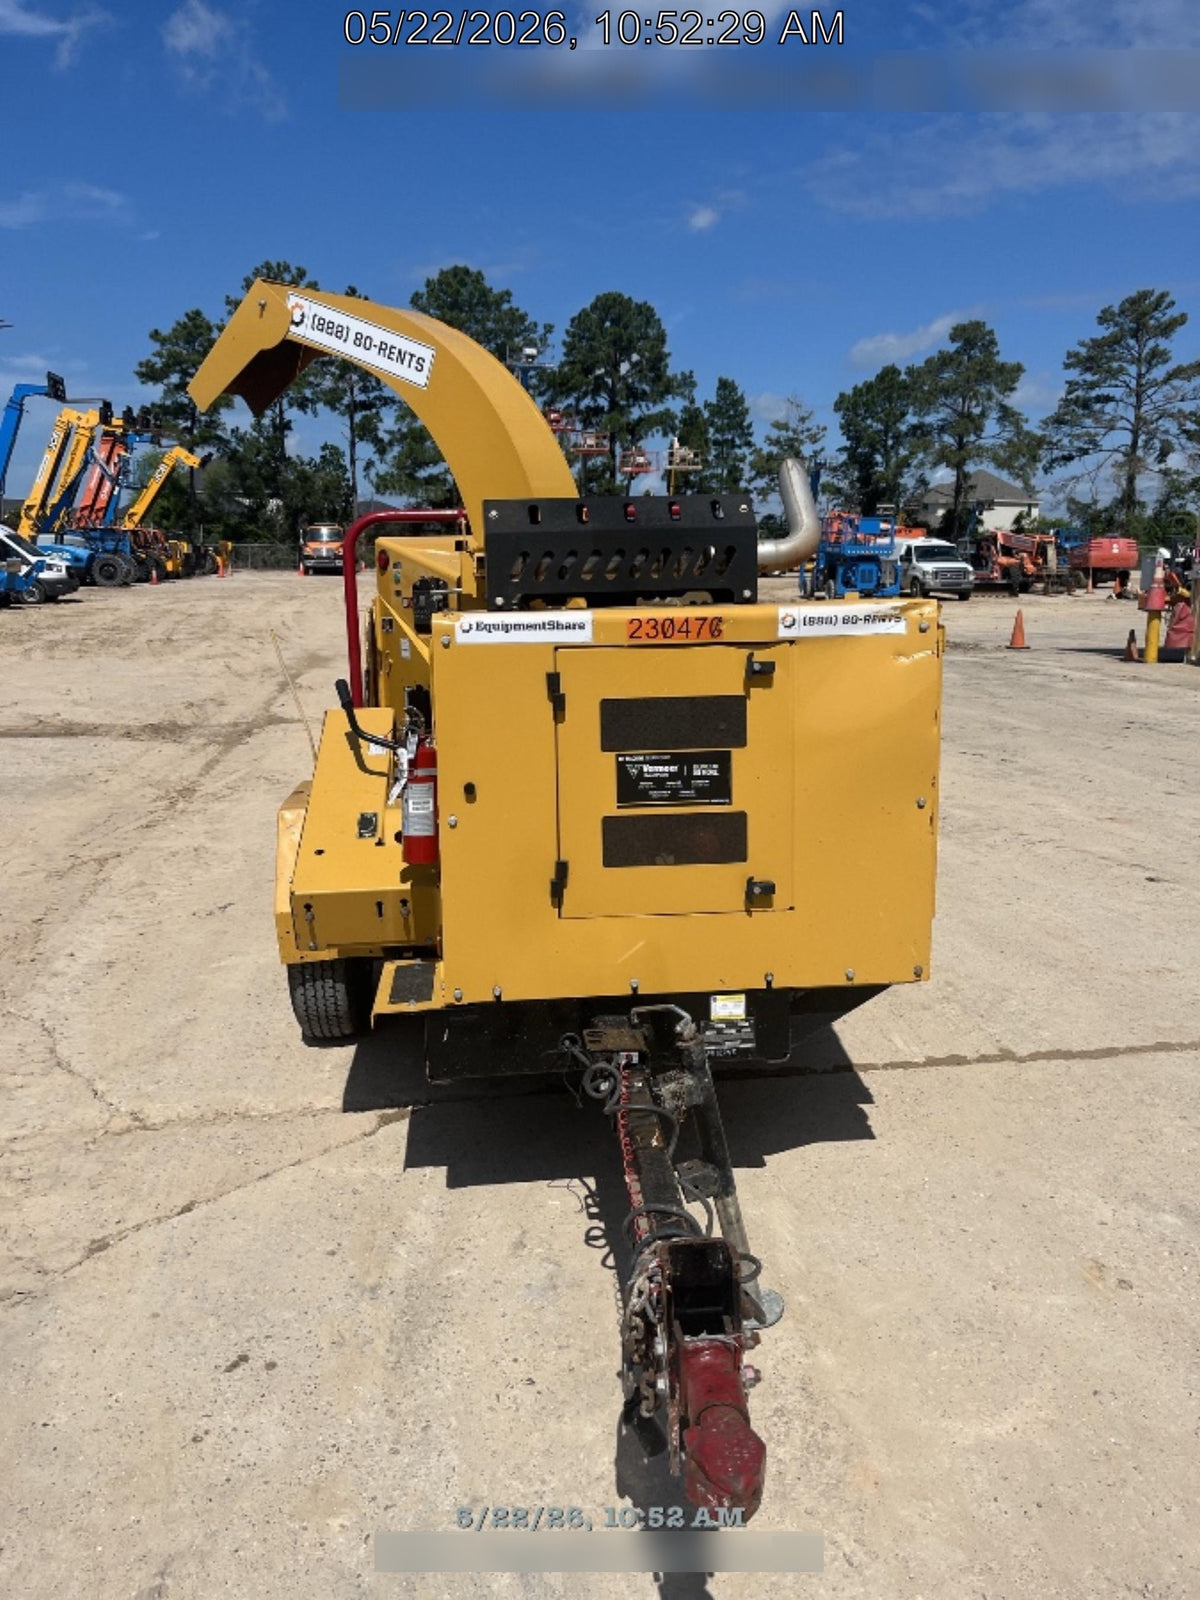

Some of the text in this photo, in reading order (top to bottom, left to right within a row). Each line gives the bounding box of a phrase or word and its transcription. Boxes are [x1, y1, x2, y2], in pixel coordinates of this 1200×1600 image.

[311, 313, 426, 373] (888) 80-RENTS
[475, 620, 586, 633] EquipmentShare
